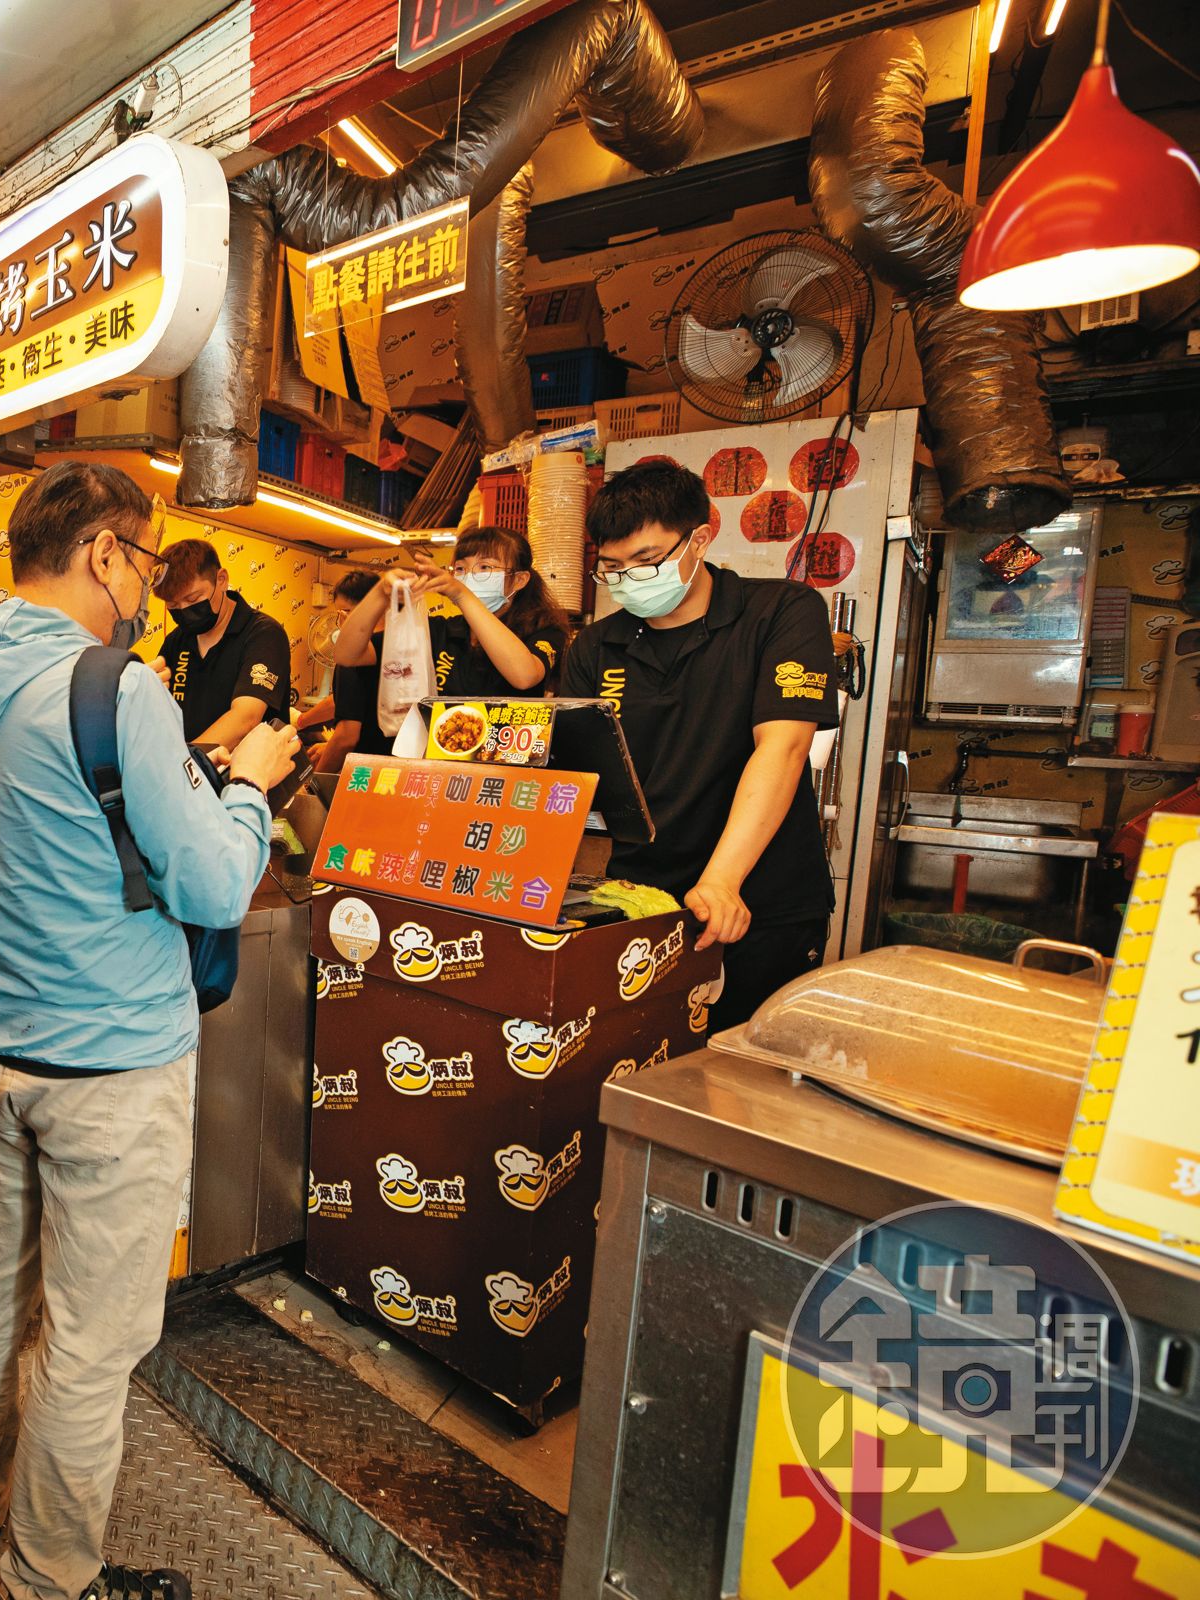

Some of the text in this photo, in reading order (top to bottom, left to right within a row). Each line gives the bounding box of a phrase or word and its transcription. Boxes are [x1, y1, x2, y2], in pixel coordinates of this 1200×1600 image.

[311, 224, 460, 315] 點餐請往前
[173, 651, 190, 701] UNCLE
[439, 940, 481, 961] 炳叔
[444, 964, 462, 972] UNCLE
[430, 1061, 470, 1078] 炳叔
